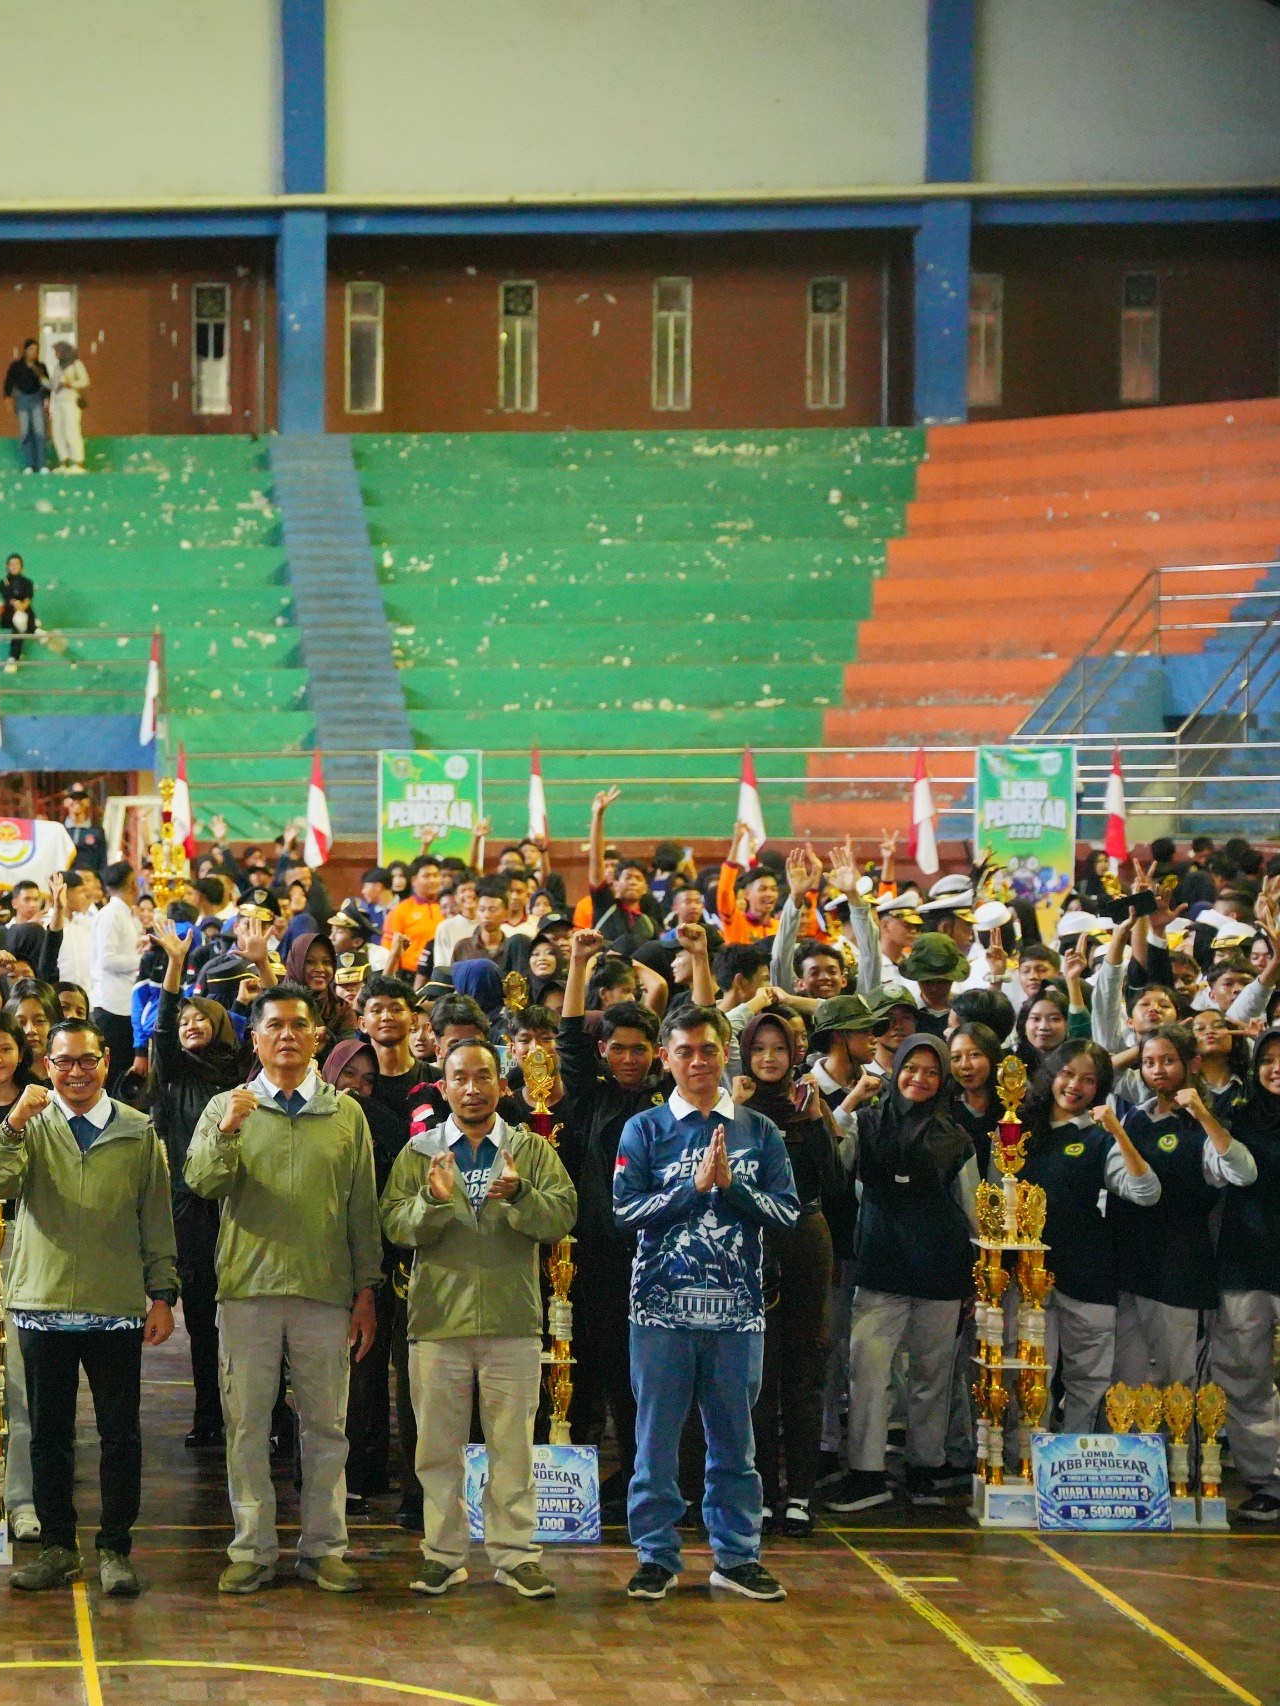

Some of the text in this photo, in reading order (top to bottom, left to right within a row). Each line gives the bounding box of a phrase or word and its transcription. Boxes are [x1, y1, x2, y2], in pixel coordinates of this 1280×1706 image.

[388, 801, 473, 830] PENDEKAR
[984, 799, 1067, 830] PENDEKAR
[1050, 1459, 1150, 1477] LKBB PENDEKAR
[533, 1470, 583, 1488] NDEKAR
[1056, 1487, 1149, 1500] JUARA HARAPAN 3
[536, 1498, 580, 1512] RAPAN 2
[1071, 1506, 1136, 1519] Rp. 500.000
